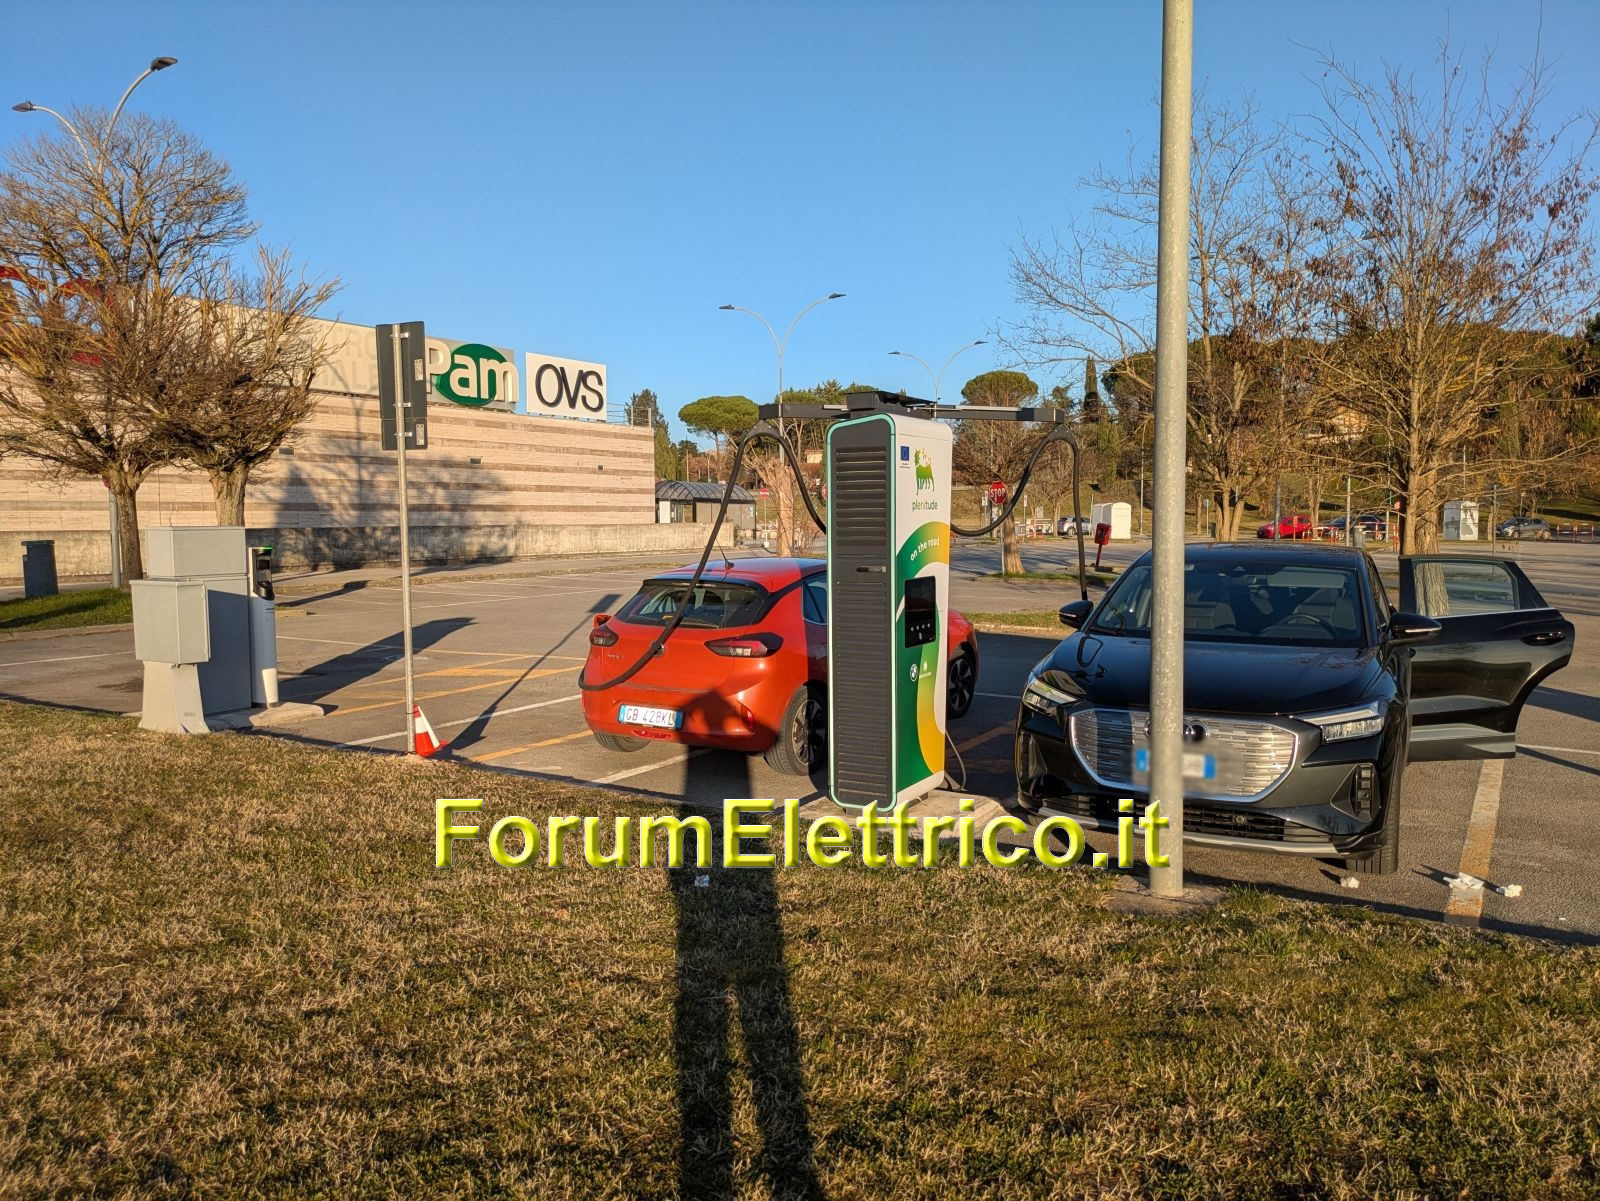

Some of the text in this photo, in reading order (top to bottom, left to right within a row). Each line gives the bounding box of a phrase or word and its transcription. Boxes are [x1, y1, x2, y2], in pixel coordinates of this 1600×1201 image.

[426, 340, 519, 402] Pam
[535, 363, 604, 412] OVS
[991, 488, 1006, 498] STOP
[912, 499, 938, 512] plenitude
[910, 536, 940, 561] on the road
[626, 708, 639, 721] GB
